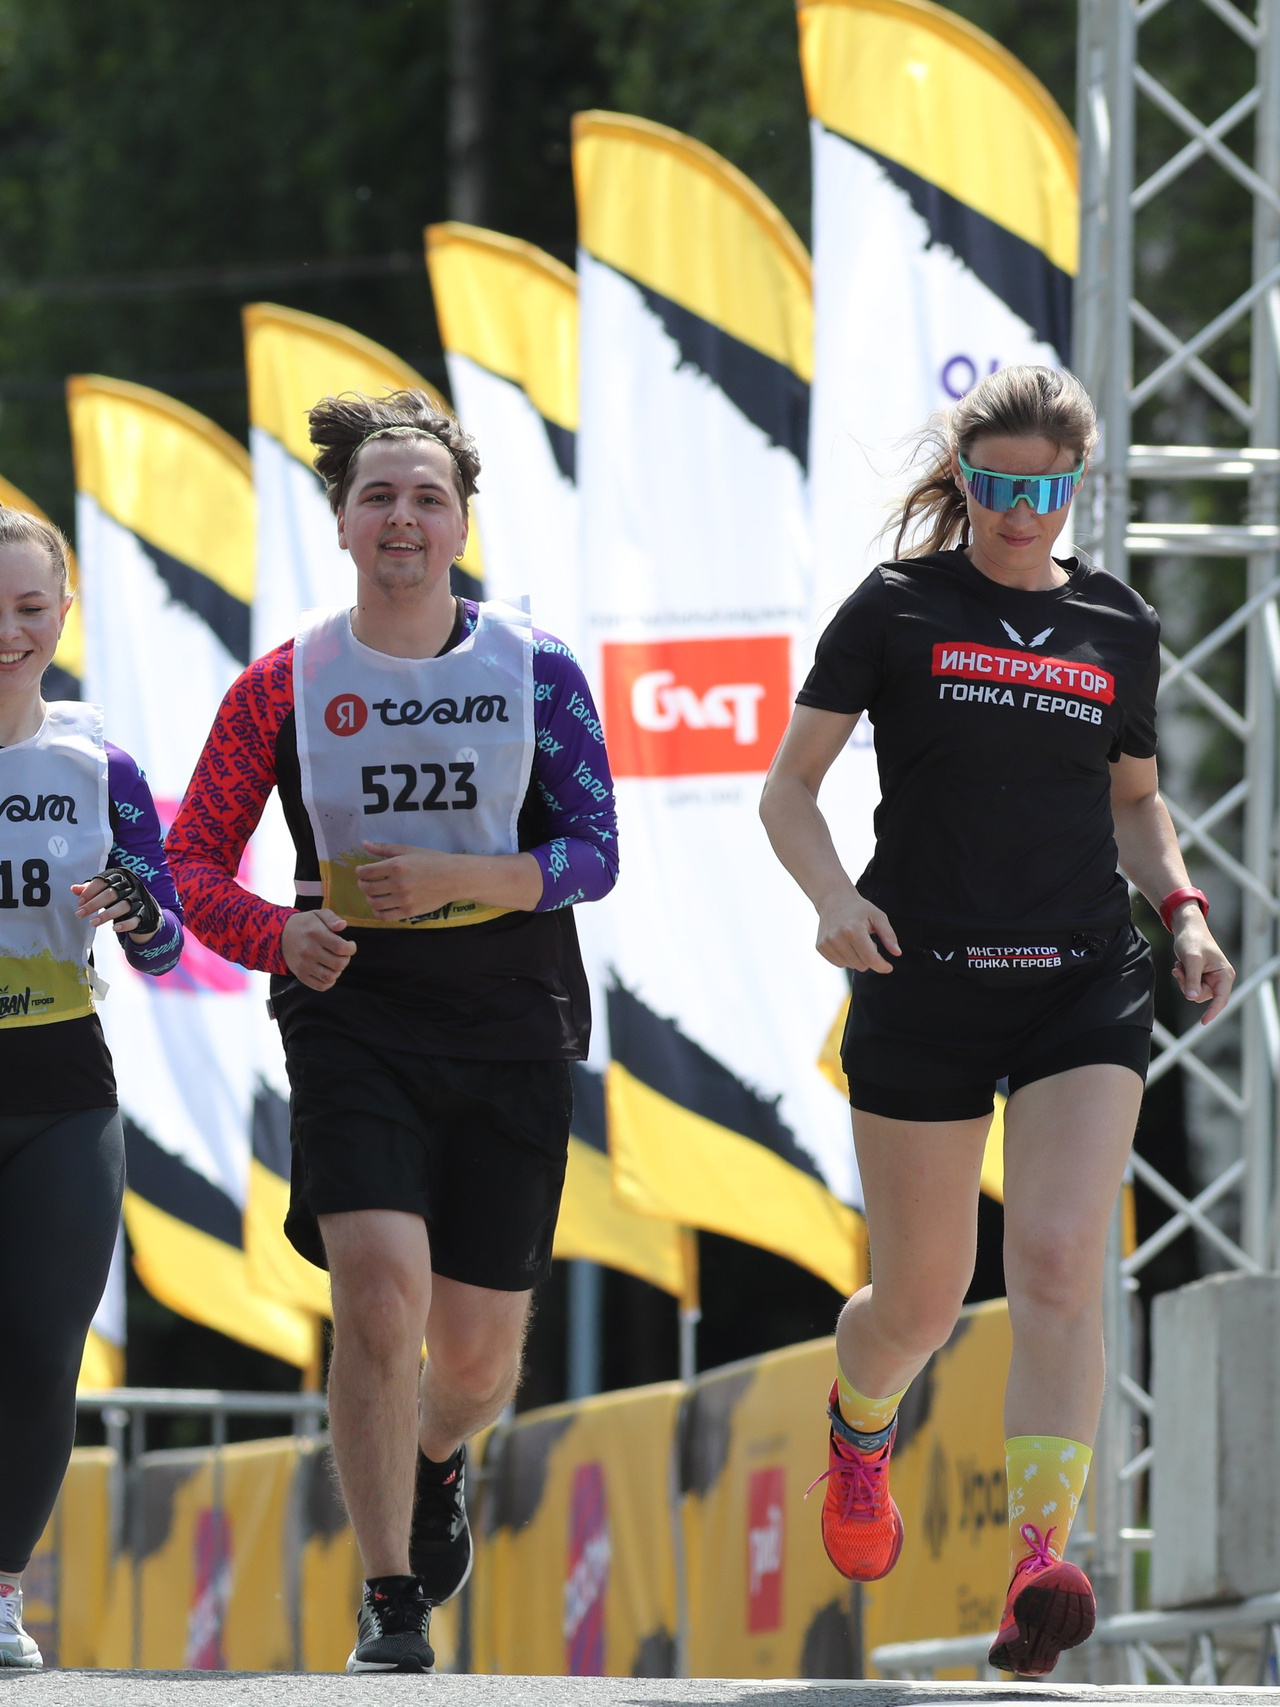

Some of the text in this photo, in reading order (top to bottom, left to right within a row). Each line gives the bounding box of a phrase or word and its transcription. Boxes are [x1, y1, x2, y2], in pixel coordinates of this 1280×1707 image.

[940, 650, 1108, 694] ИНСТРУКТОР
[373, 695, 509, 725] team
[939, 683, 1104, 726] ГОНКА ГЕРОЕВ
[362, 762, 477, 814] 5223
[966, 946, 1059, 957] ИНСТРУКТОР
[968, 957, 1062, 969] ГОНКА ГЕРОЕВ
